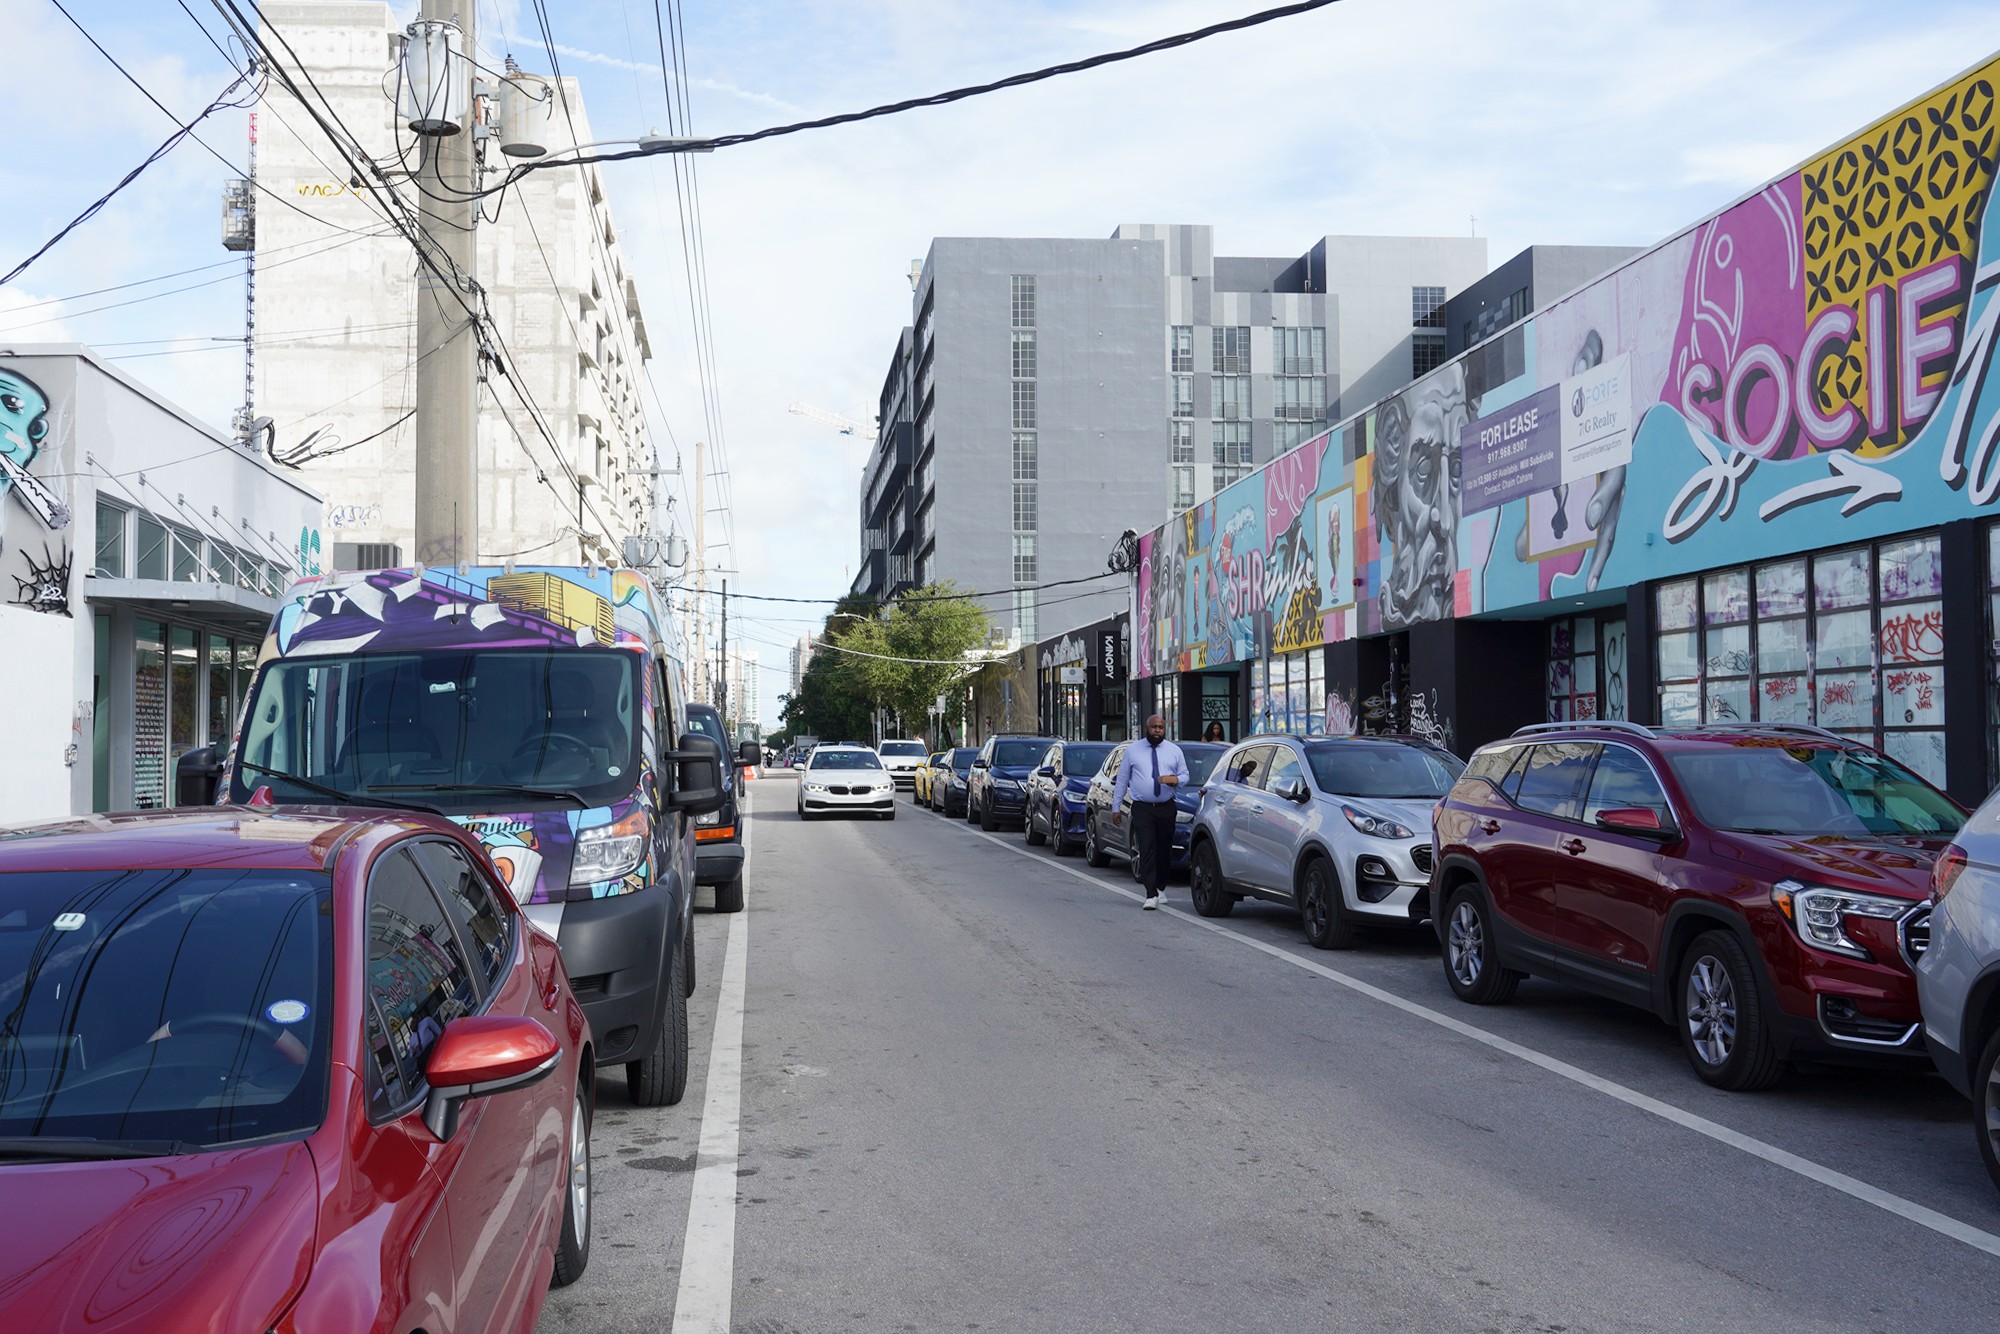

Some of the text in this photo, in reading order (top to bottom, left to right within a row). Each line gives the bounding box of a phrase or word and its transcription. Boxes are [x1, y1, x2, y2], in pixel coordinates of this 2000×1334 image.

[1480, 408, 1539, 450] FOR LEASE
[1592, 411, 1618, 432] Realty
[1530, 449, 1555, 468] Subdivide
[1104, 635, 1115, 680] KANOPY
